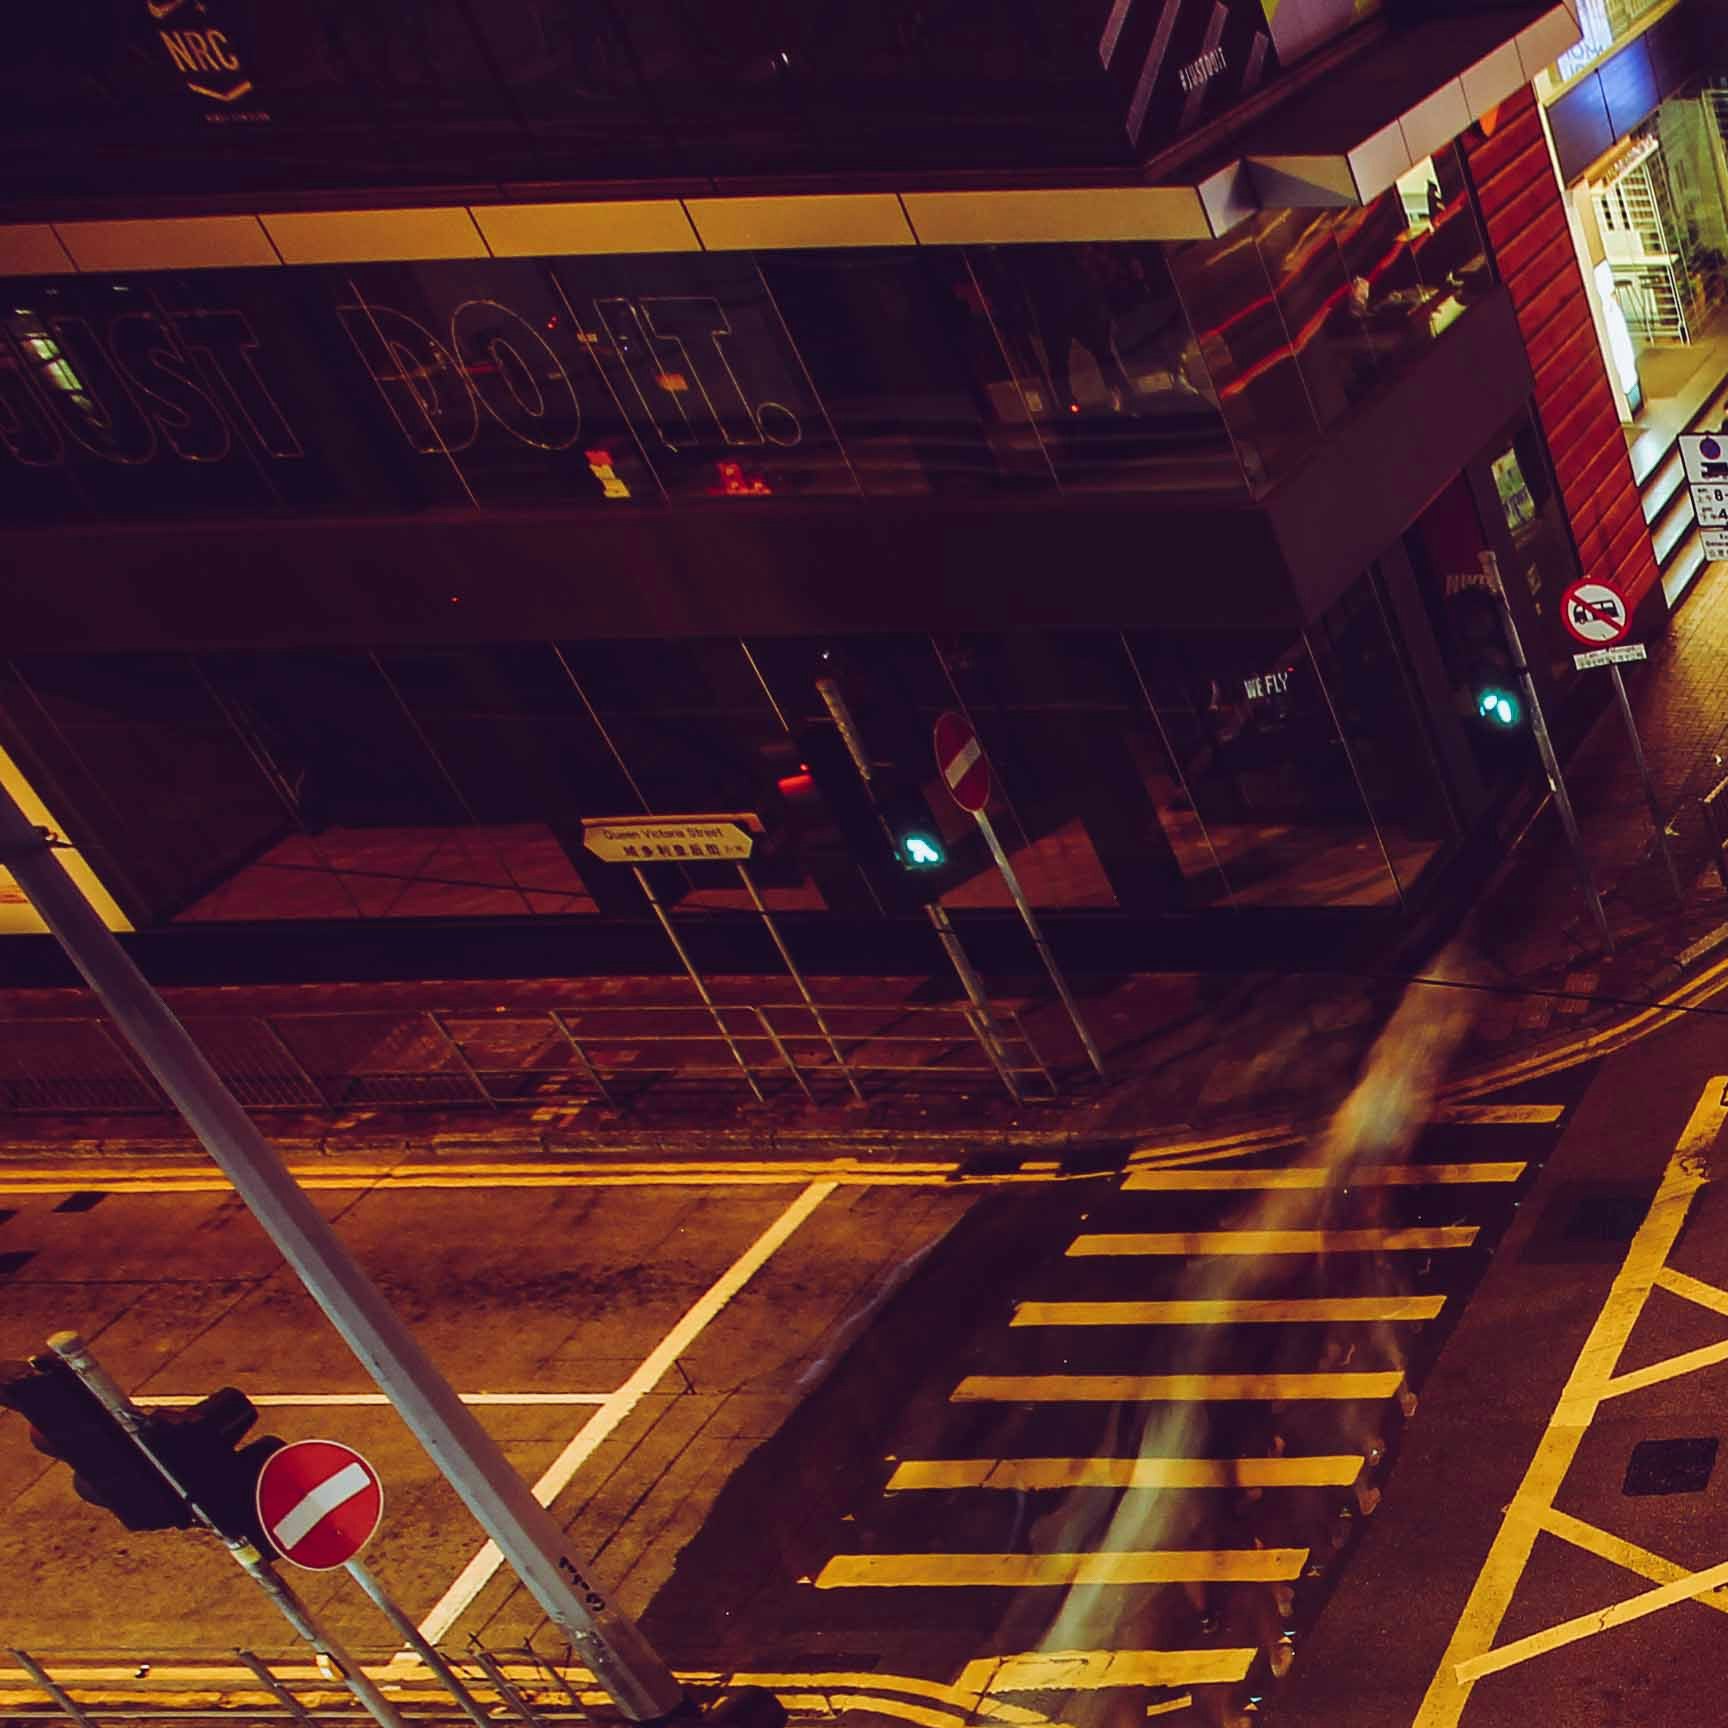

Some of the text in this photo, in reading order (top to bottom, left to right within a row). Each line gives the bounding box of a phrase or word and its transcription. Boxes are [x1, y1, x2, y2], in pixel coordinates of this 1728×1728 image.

[159, 27, 241, 73] NRC
[336, 298, 584, 456] DO
[1243, 672, 1289, 700] WE FLY
[640, 828, 686, 840] Victoria
[686, 826, 724, 838] Street
